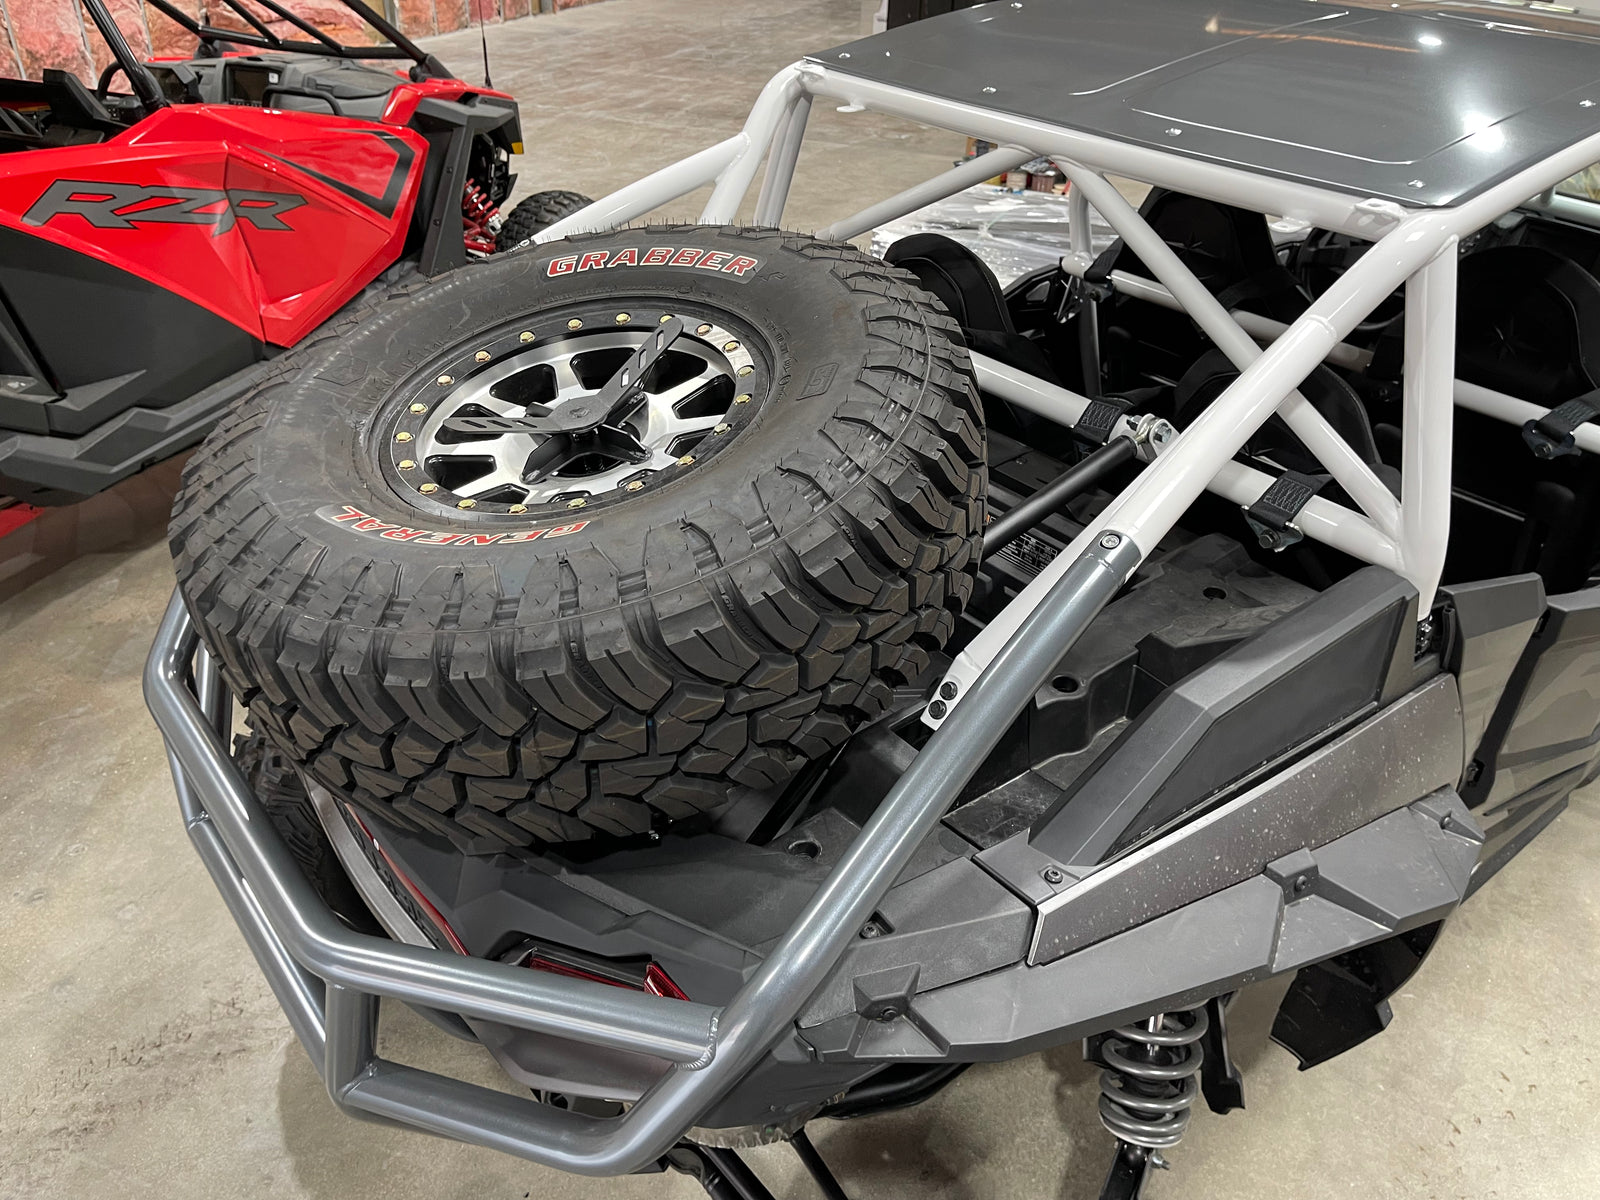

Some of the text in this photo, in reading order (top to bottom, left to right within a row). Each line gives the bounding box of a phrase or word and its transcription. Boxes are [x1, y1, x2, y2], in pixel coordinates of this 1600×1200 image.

[20, 179, 309, 237] RZR
[547, 247, 758, 277] GRABBER
[330, 505, 592, 545] GENERAL
